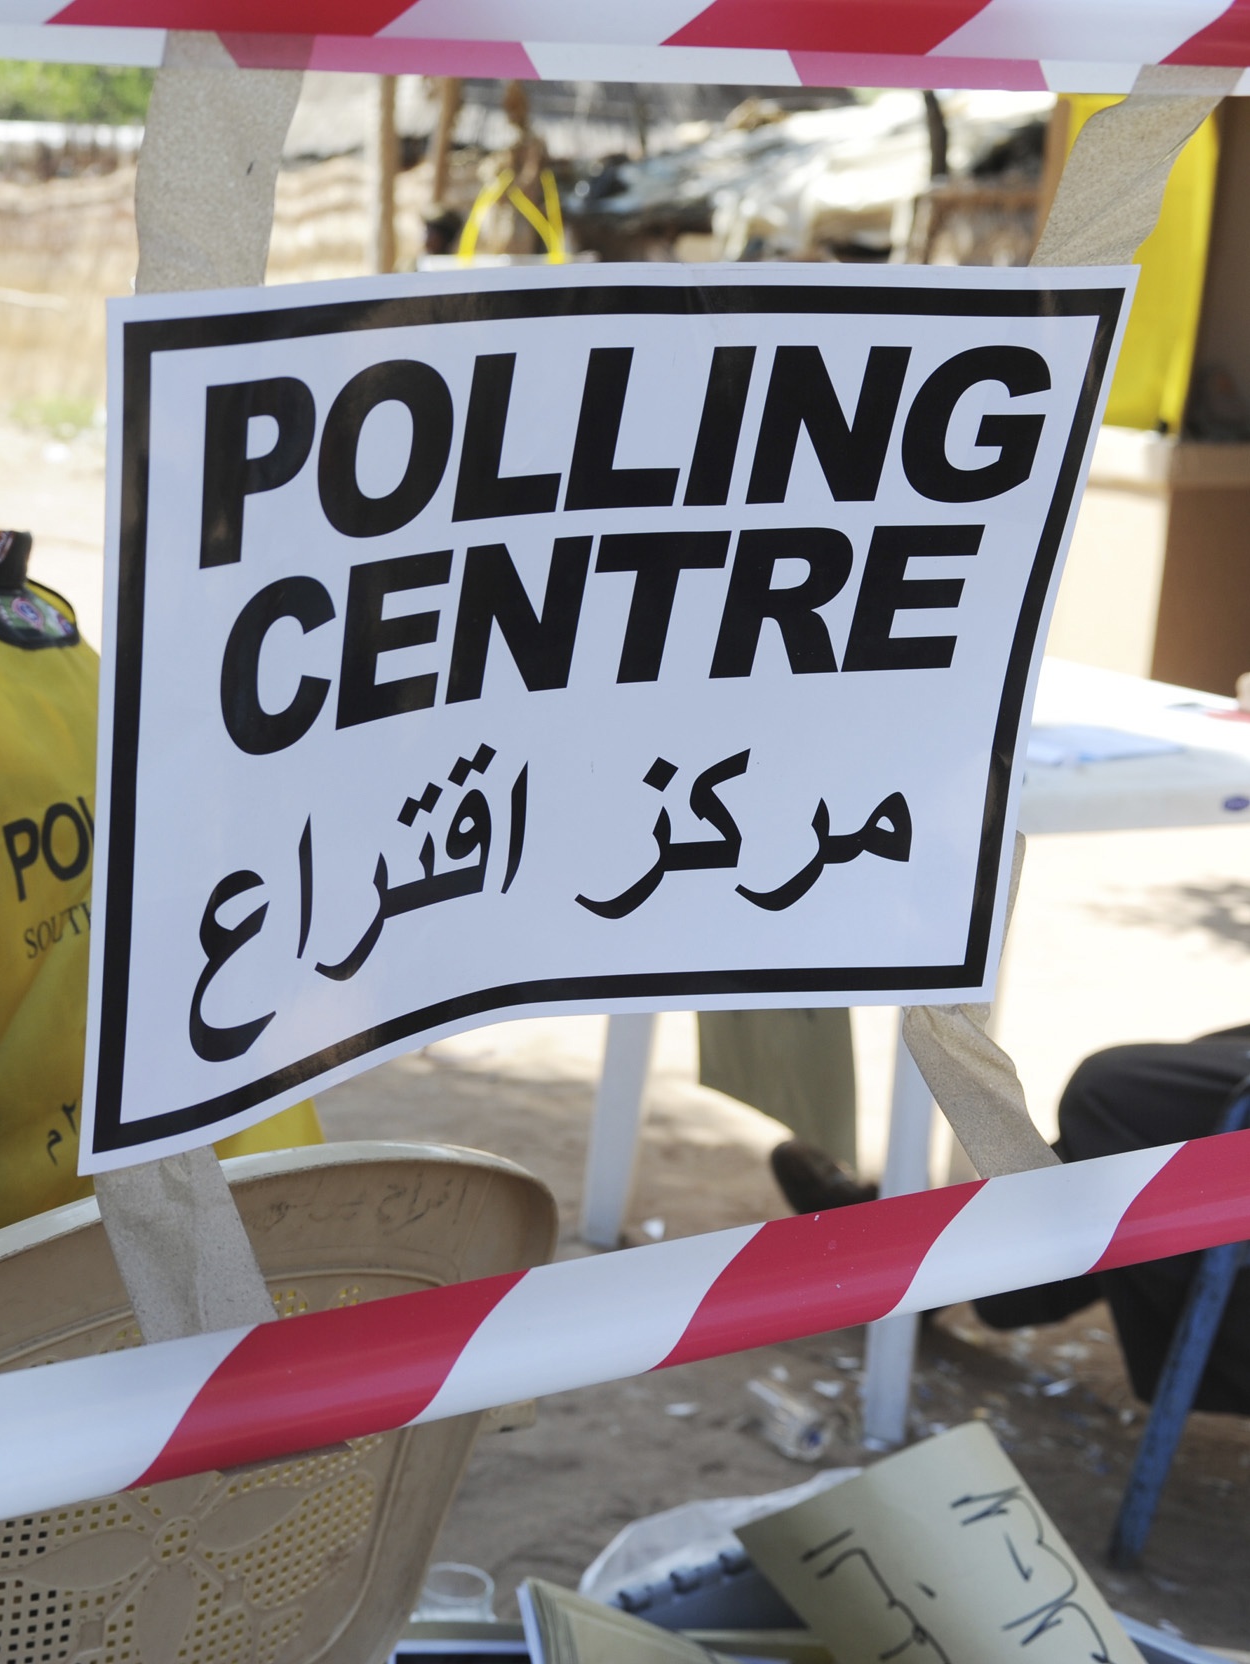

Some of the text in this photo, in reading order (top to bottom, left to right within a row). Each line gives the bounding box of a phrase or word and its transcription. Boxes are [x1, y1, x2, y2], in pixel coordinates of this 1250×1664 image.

[199, 345, 1052, 570] POLLING
[220, 524, 986, 756] CENTRE
[189, 742, 913, 1063] مركز اقتراع
